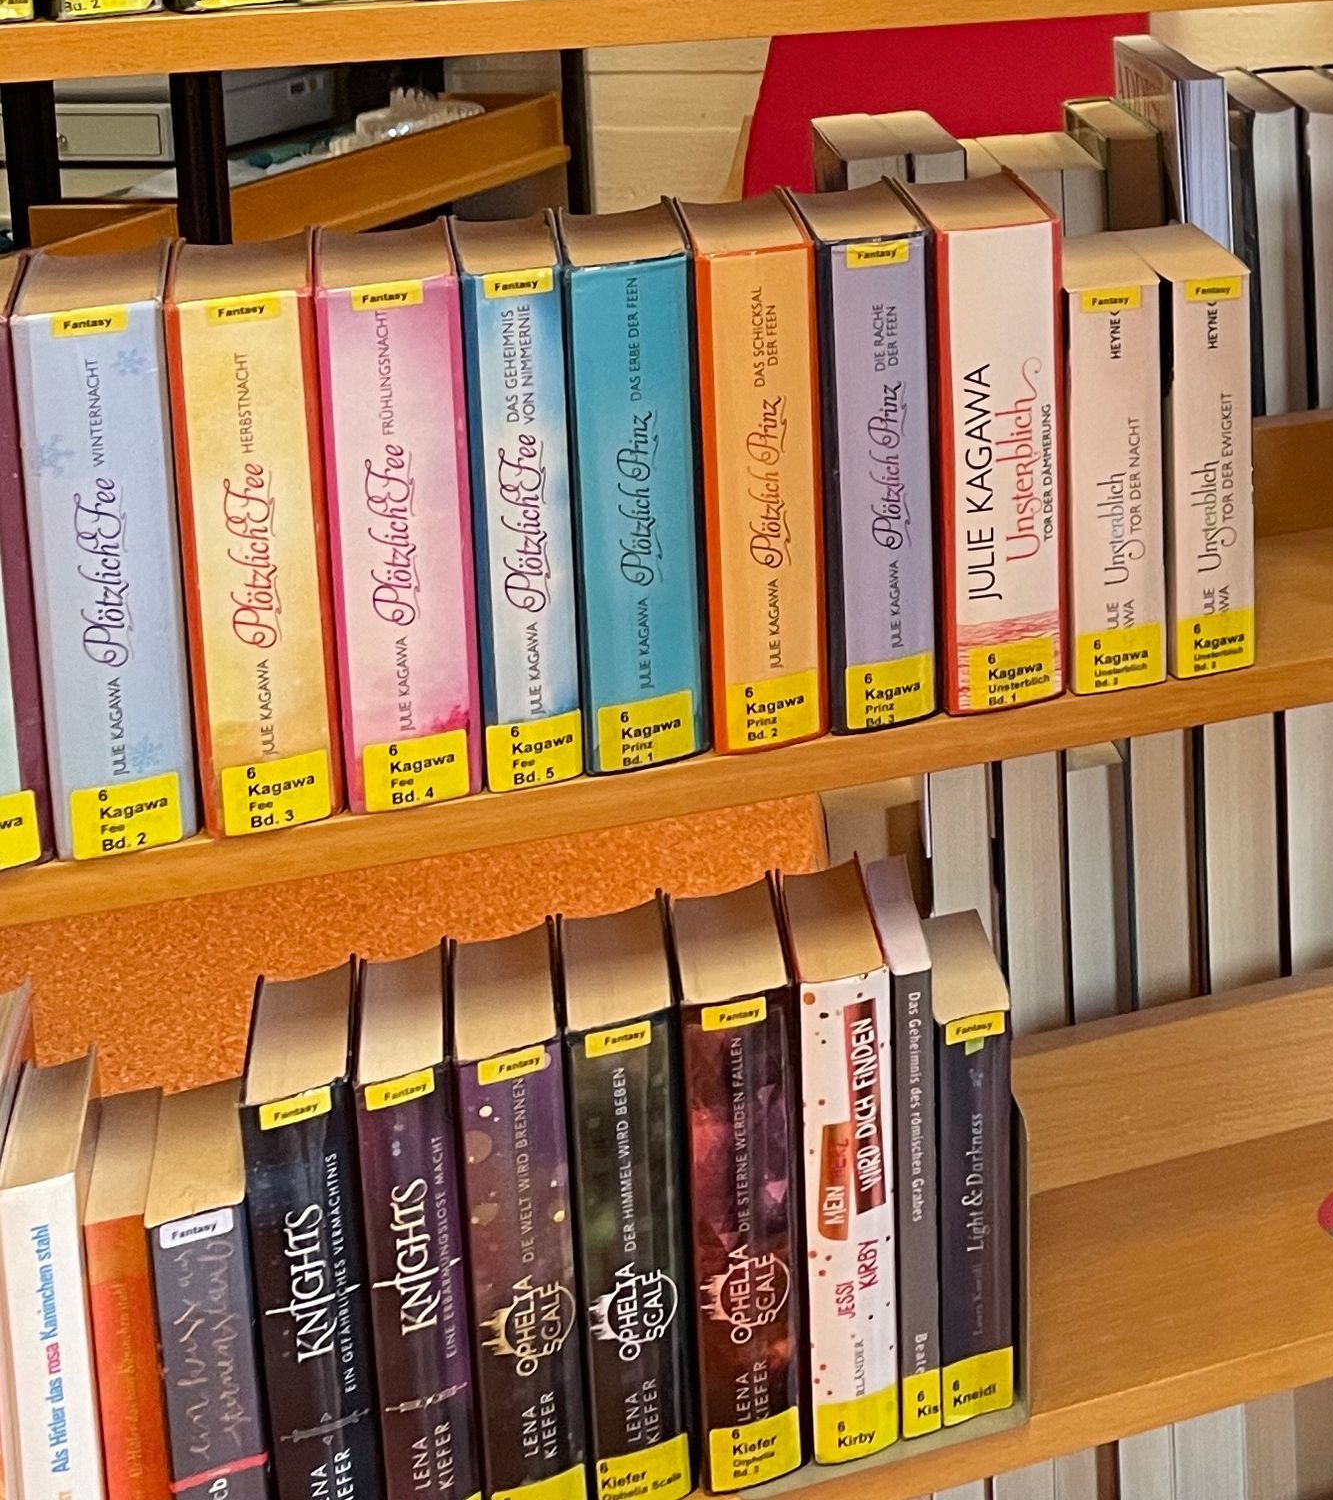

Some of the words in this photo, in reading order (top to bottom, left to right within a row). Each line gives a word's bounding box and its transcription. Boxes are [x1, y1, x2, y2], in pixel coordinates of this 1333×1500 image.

[63, 317, 112, 330] Fantasy
[501, 309, 519, 387] GEHEIMNIS
[517, 303, 533, 389] NIMMERNIE
[375, 310, 394, 435] FRÜHLINGSNACHT
[85, 358, 105, 467] WINTERNACHT
[234, 352, 255, 454] HERBSTNACHT
[507, 390, 521, 423] DAS
[521, 393, 535, 426] VON
[964, 363, 993, 513] KAGAWA
[1041, 404, 1053, 487] DÄMMERUNG
[995, 356, 1042, 563] Unsterblich
[1043, 489, 1053, 516] DER
[1044, 518, 1053, 542] TOR
[969, 526, 1003, 601] JULIE
[100, 796, 168, 821] Kagawa
[908, 992, 919, 1015] Das
[908, 1019, 922, 1085] Geheimnis
[910, 1088, 921, 1106] des
[910, 1109, 921, 1174] römischen
[966, 1113, 984, 1188] Darkness
[911, 1173, 925, 1222] Grabes
[962, 1189, 984, 1208] &
[31, 1224, 52, 1260] stahl
[967, 1207, 991, 1252] Light
[858, 1238, 879, 1291] KIRBY
[38, 1264, 59, 1341] Kaninchen
[835, 1280, 856, 1319] JESSI
[46, 1342, 61, 1375] rosa
[46, 1377, 65, 1403] das
[49, 1408, 67, 1447] Hitler
[838, 1430, 876, 1448] Kirby
[51, 1448, 70, 1475] Als
